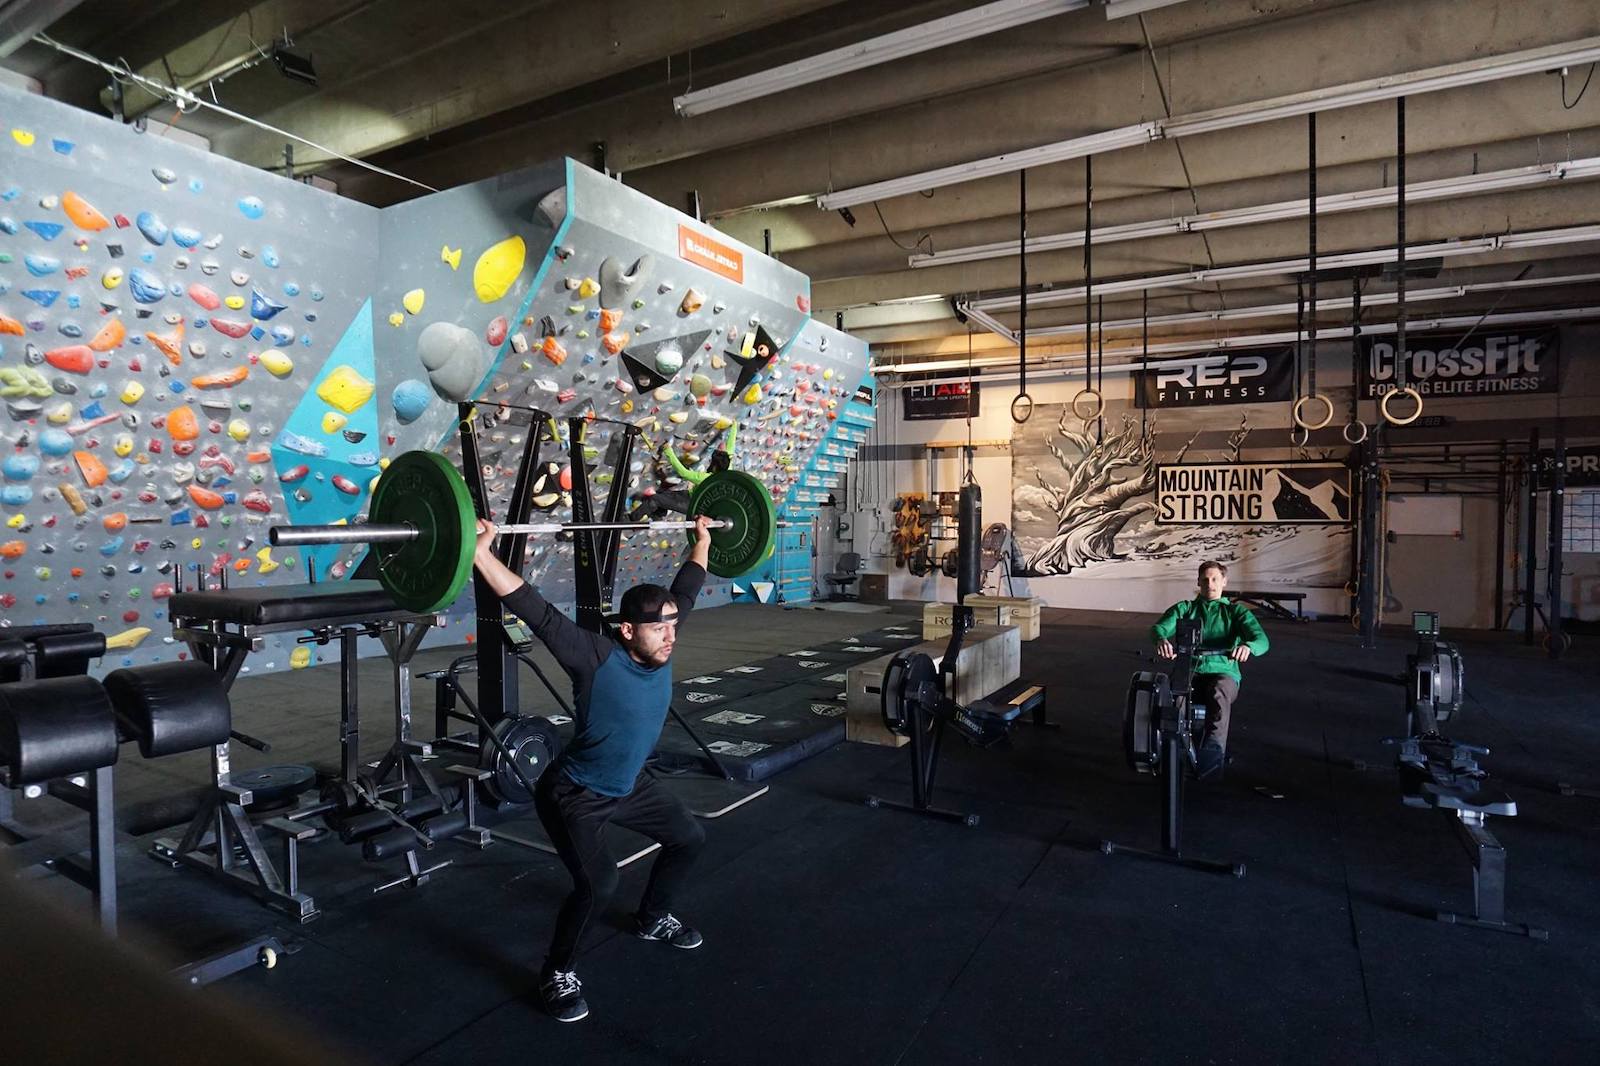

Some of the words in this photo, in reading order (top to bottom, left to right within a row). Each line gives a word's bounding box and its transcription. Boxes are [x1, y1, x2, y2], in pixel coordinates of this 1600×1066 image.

[1157, 356, 1267, 389] REP
[1159, 386, 1265, 401] FITNESS
[1434, 379, 1473, 394] ELITE
[1477, 377, 1539, 392] FITNESS
[1161, 469, 1263, 492] MOUNTAIN
[1161, 494, 1262, 520] STRONG
